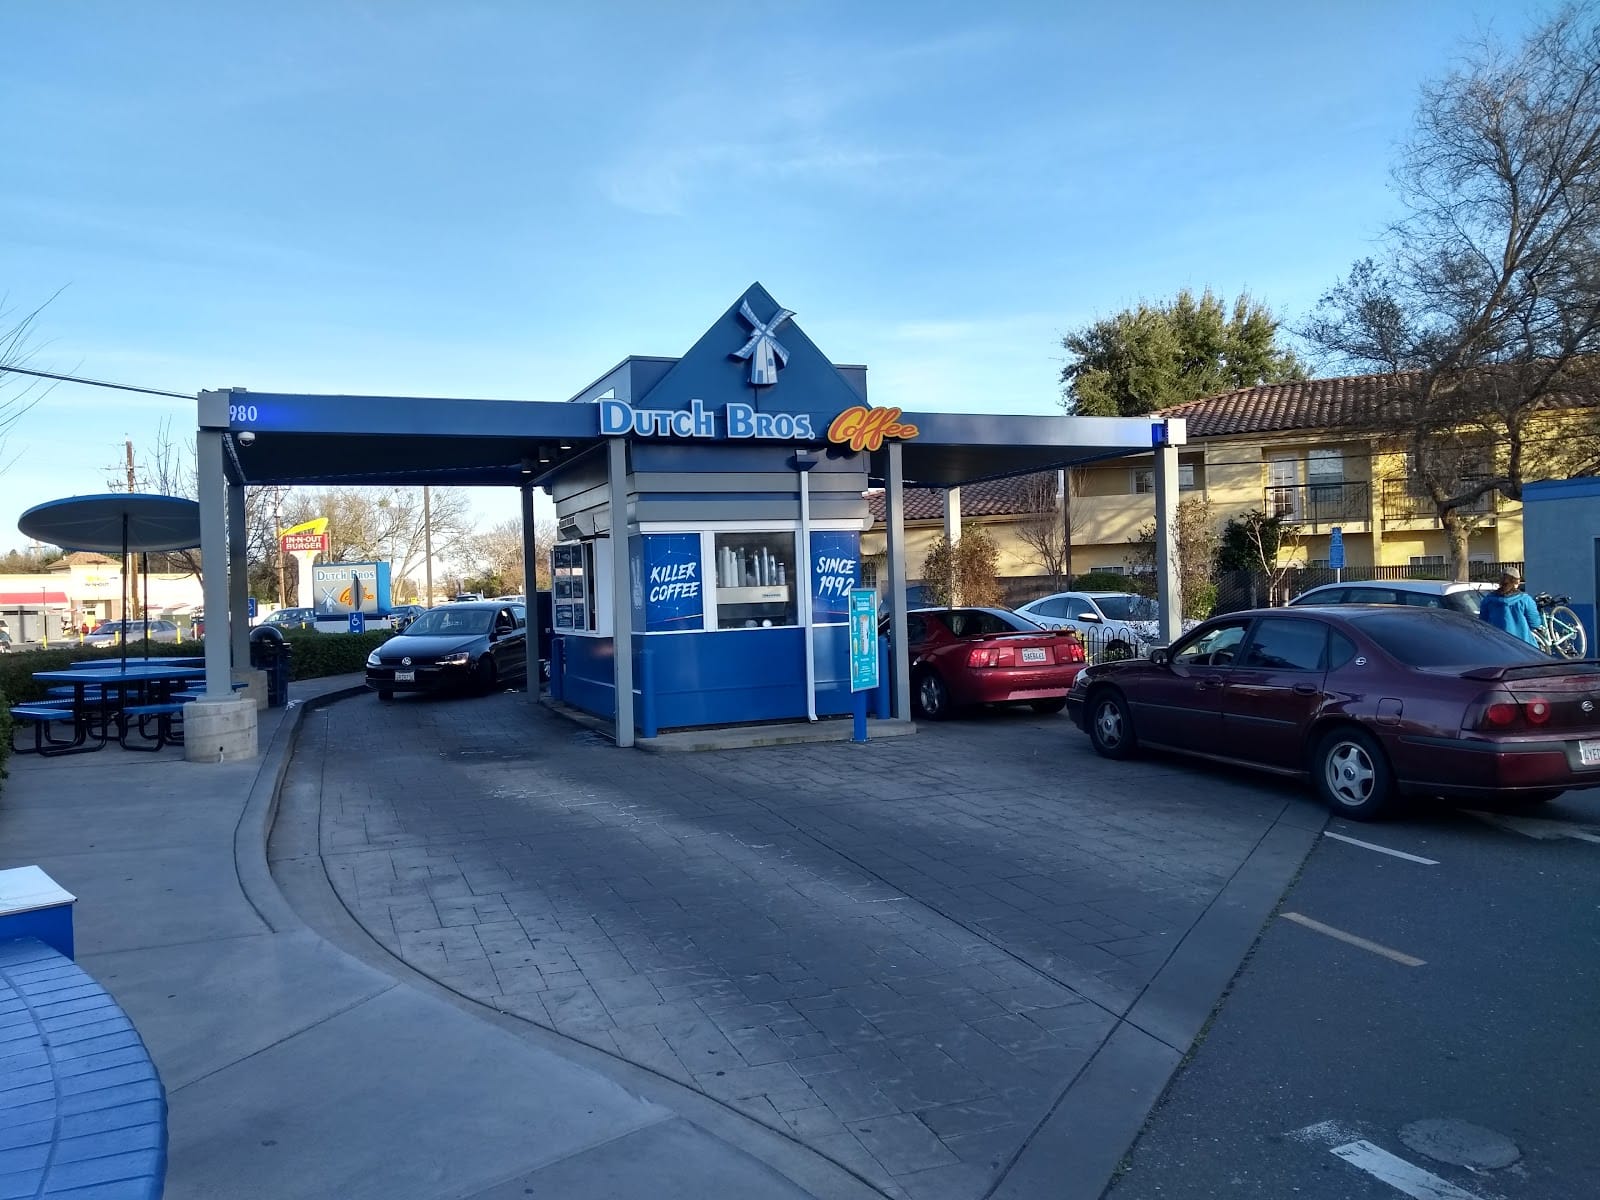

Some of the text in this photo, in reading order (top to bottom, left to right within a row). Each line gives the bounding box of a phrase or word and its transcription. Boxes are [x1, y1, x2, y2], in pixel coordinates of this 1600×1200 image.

[229, 405, 258, 421] 980
[828, 406, 920, 451] Coffee
[286, 535, 322, 543] IN-N-OUT
[286, 542, 322, 550] BURGER
[650, 562, 697, 583] KILLER
[816, 556, 857, 574] SINCE
[649, 582, 701, 602] COFFEE
[818, 575, 855, 597] 1992
